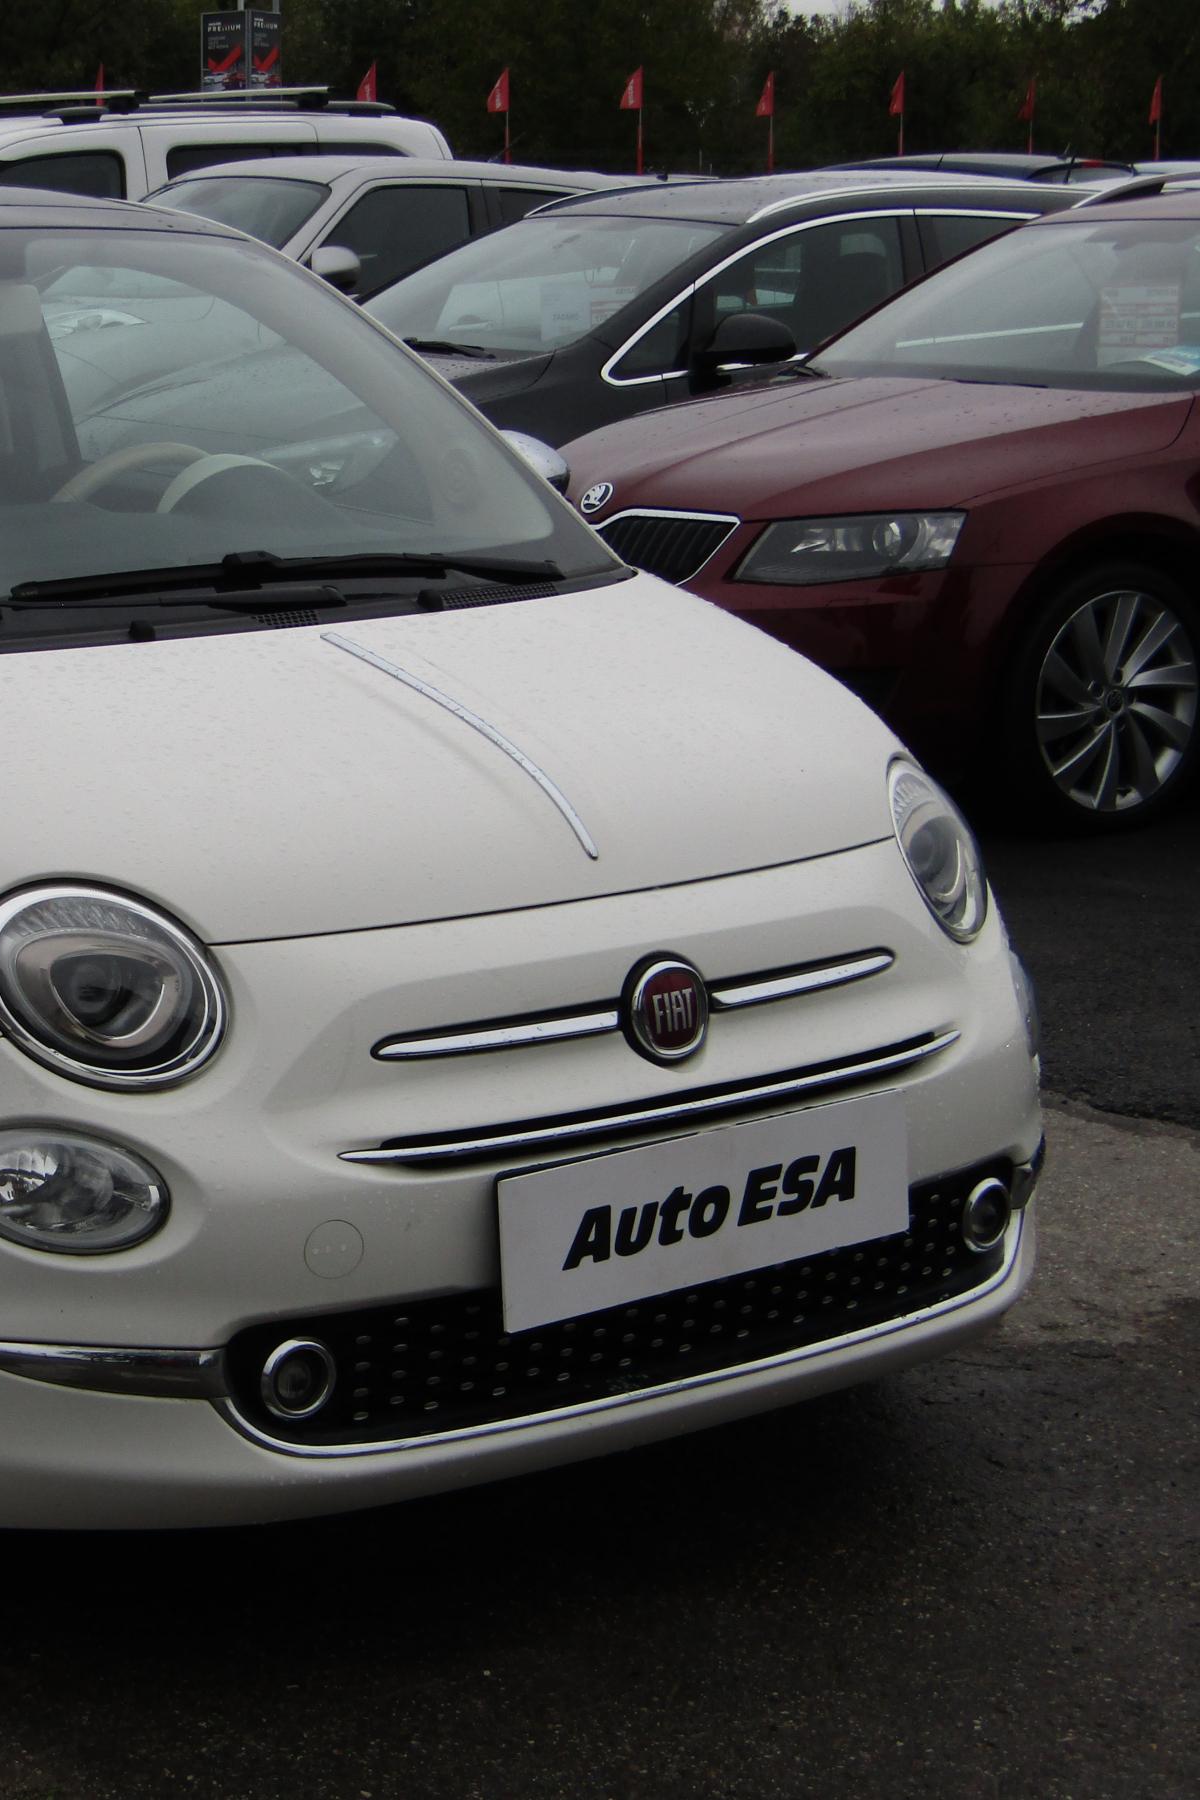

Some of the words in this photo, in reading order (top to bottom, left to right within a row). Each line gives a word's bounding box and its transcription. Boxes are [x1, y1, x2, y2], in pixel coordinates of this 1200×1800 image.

[651, 987, 693, 1034] FIAT
[562, 1185, 731, 1271] Auto
[737, 1146, 857, 1227] ESA
